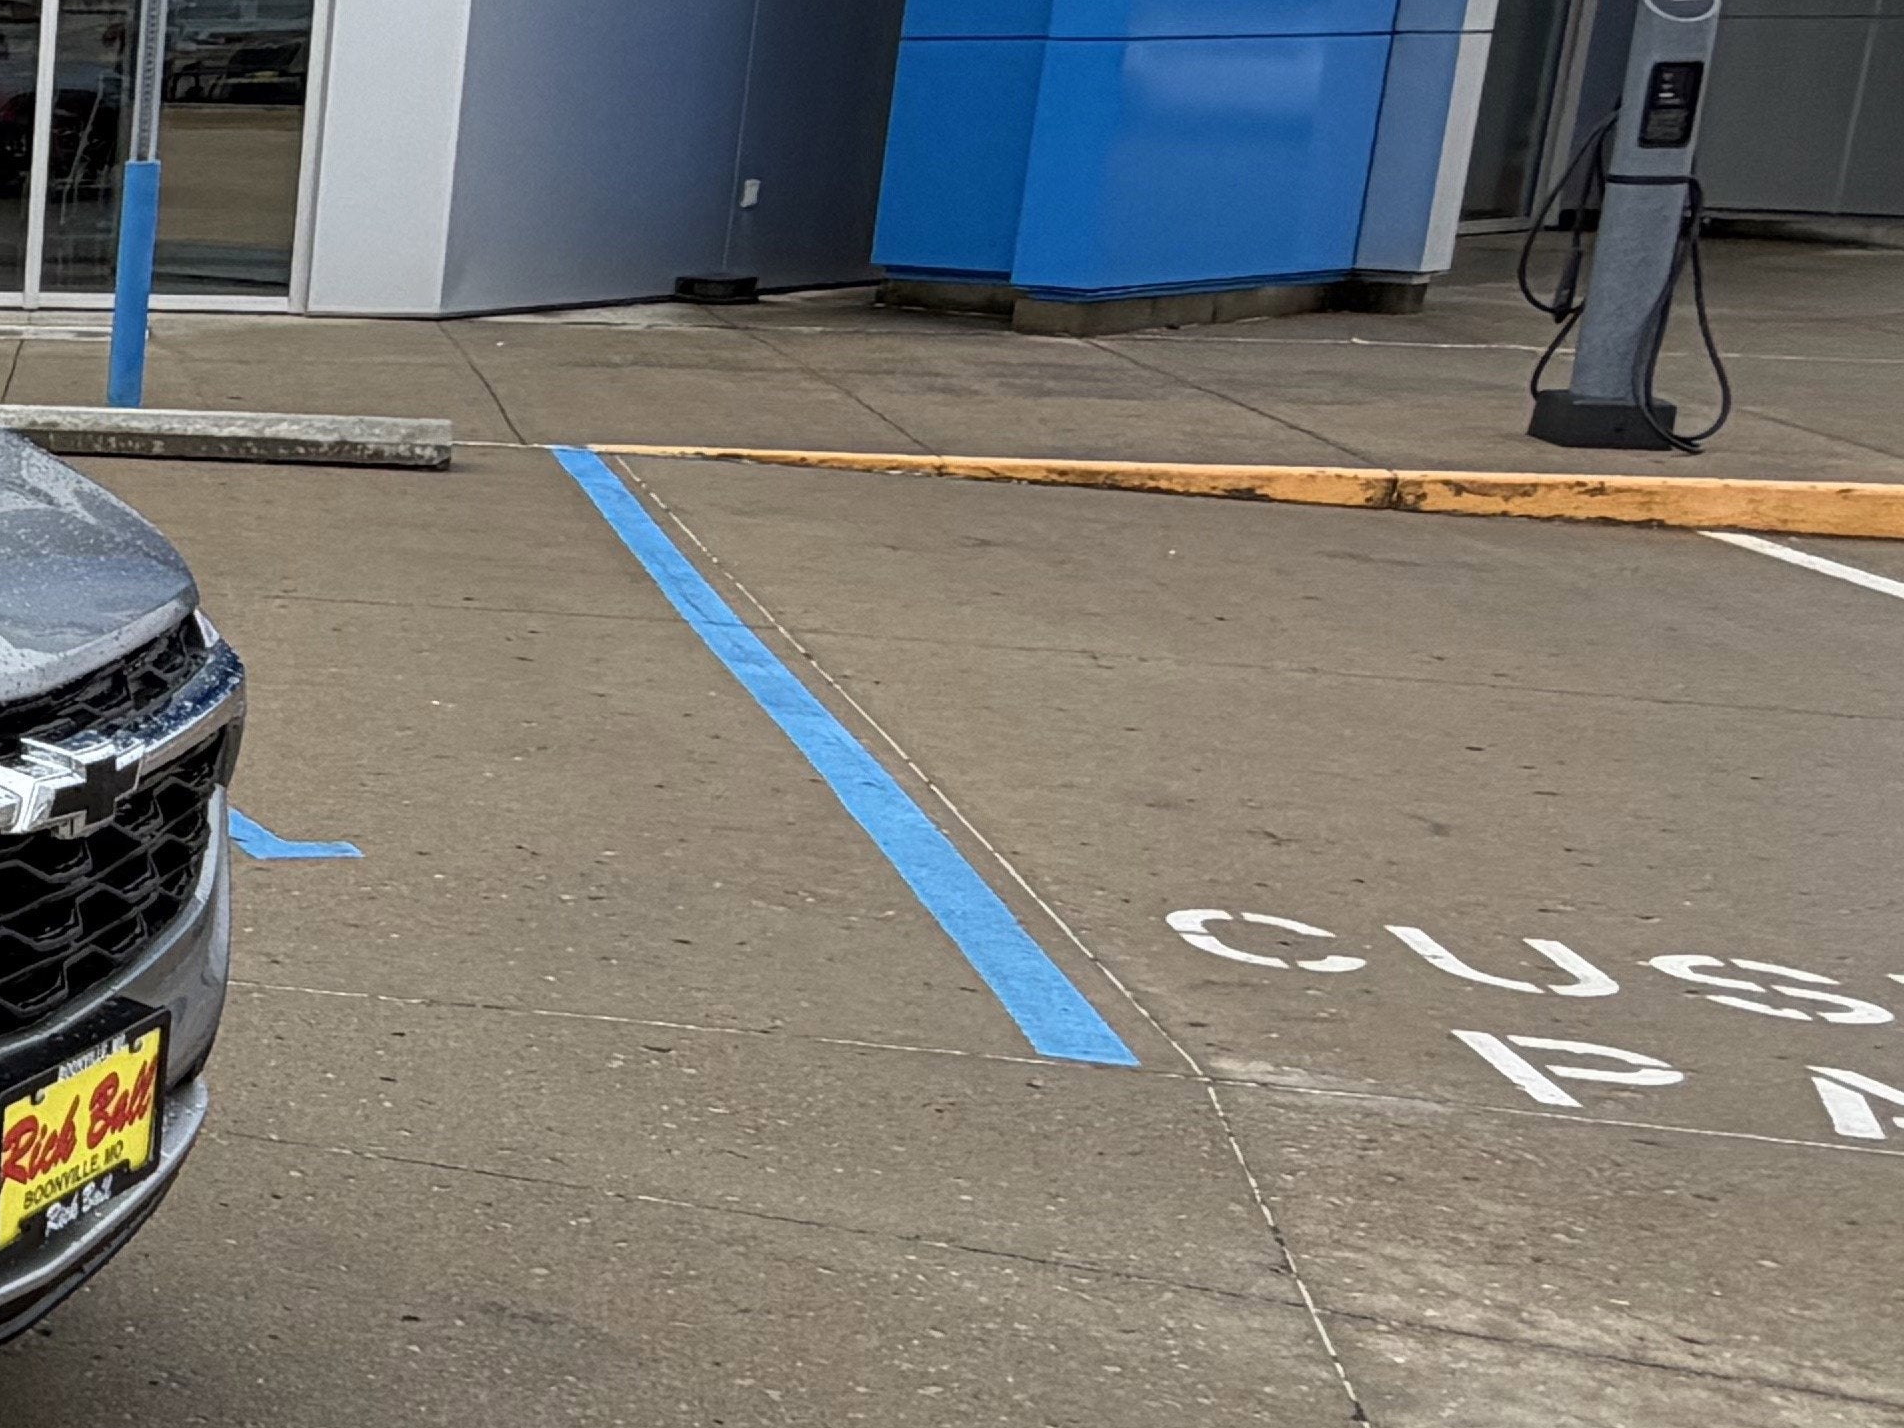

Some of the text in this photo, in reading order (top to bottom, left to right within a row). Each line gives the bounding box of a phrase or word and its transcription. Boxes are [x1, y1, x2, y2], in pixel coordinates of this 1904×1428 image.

[1165, 908, 1904, 1025] CUS
[0, 1094, 80, 1185] Rick
[86, 1056, 159, 1150] Ball
[23, 1140, 124, 1210] BOONVILLE MO
